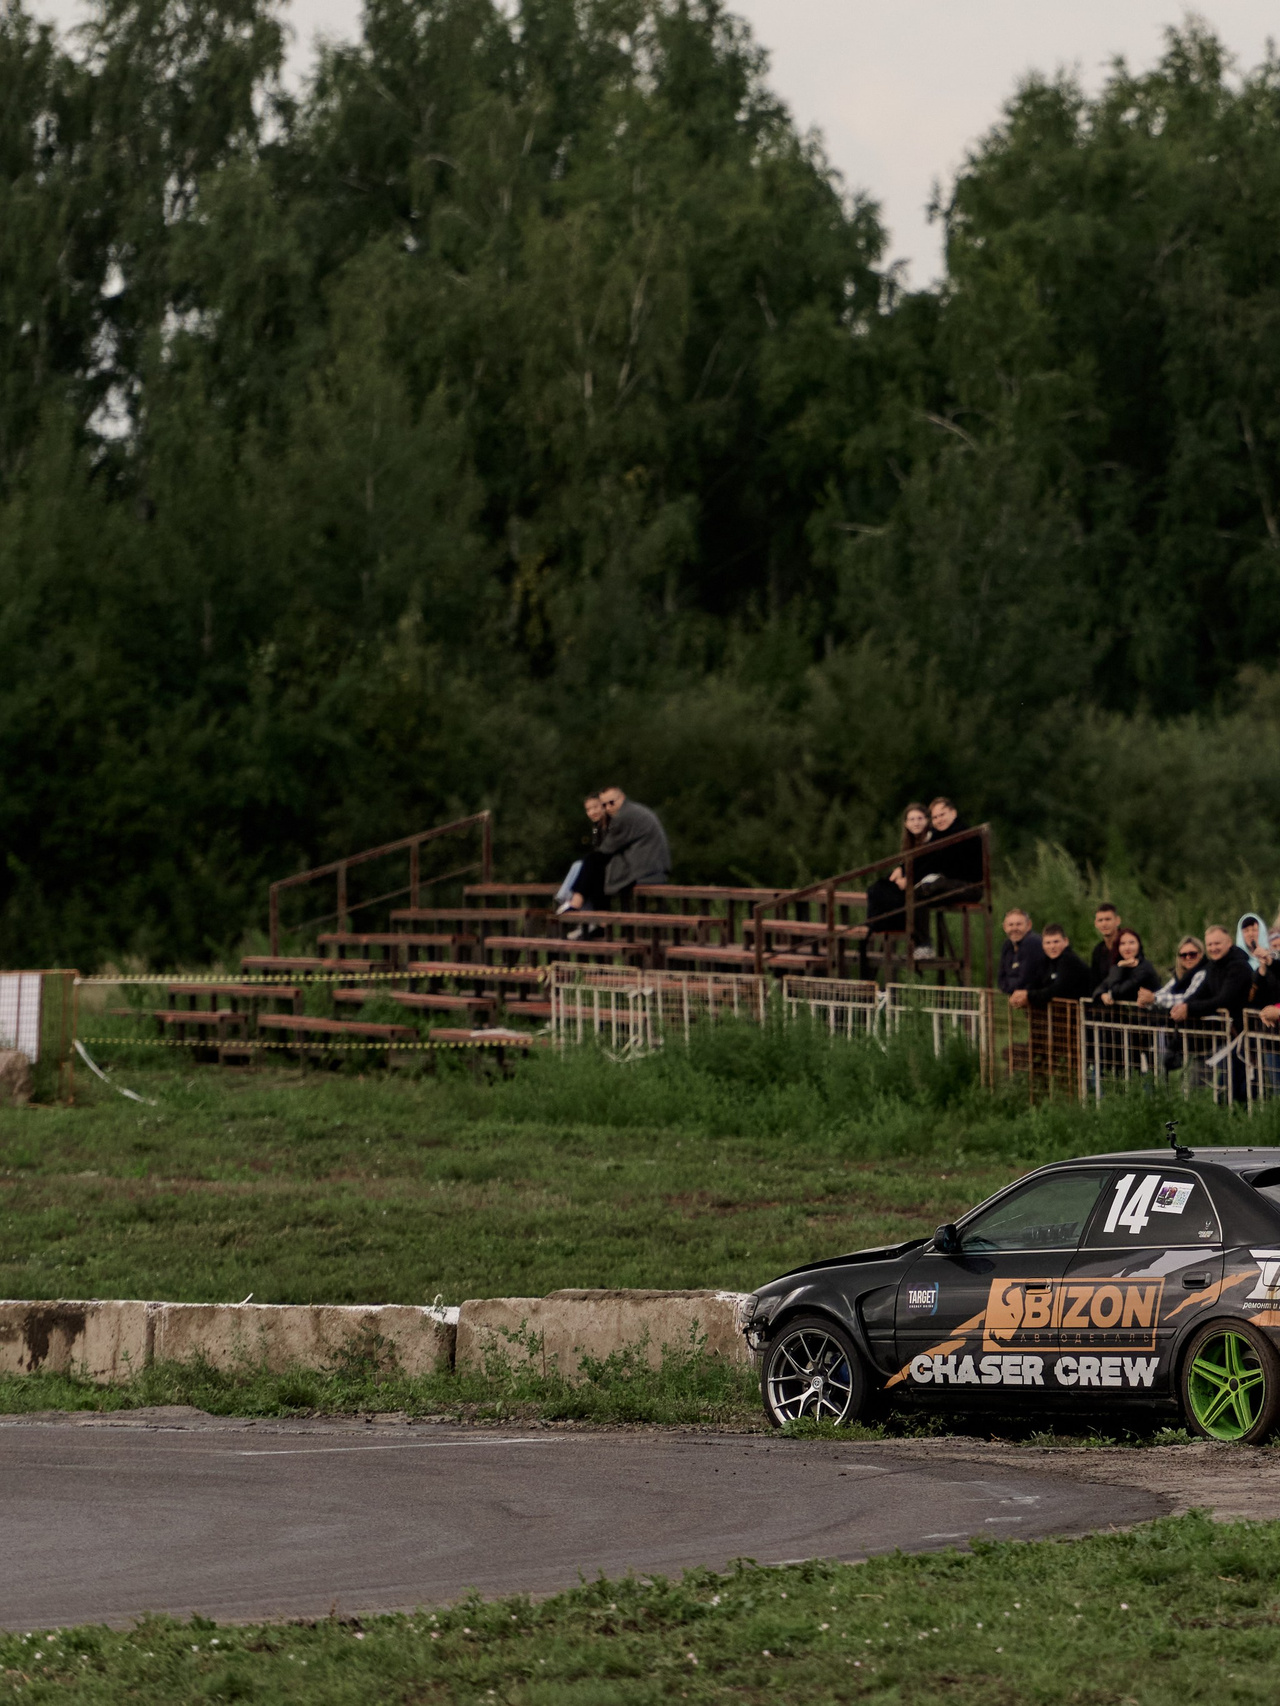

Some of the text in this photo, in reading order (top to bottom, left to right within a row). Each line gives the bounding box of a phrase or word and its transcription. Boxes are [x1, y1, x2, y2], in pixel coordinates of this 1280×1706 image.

[1103, 1174, 1161, 1234] 14
[909, 1290, 936, 1304] TARGET
[1021, 1285, 1157, 1328] BIZON
[1242, 1302, 1272, 1310] ремонт
[910, 1354, 1160, 1387] CHASER CREW
